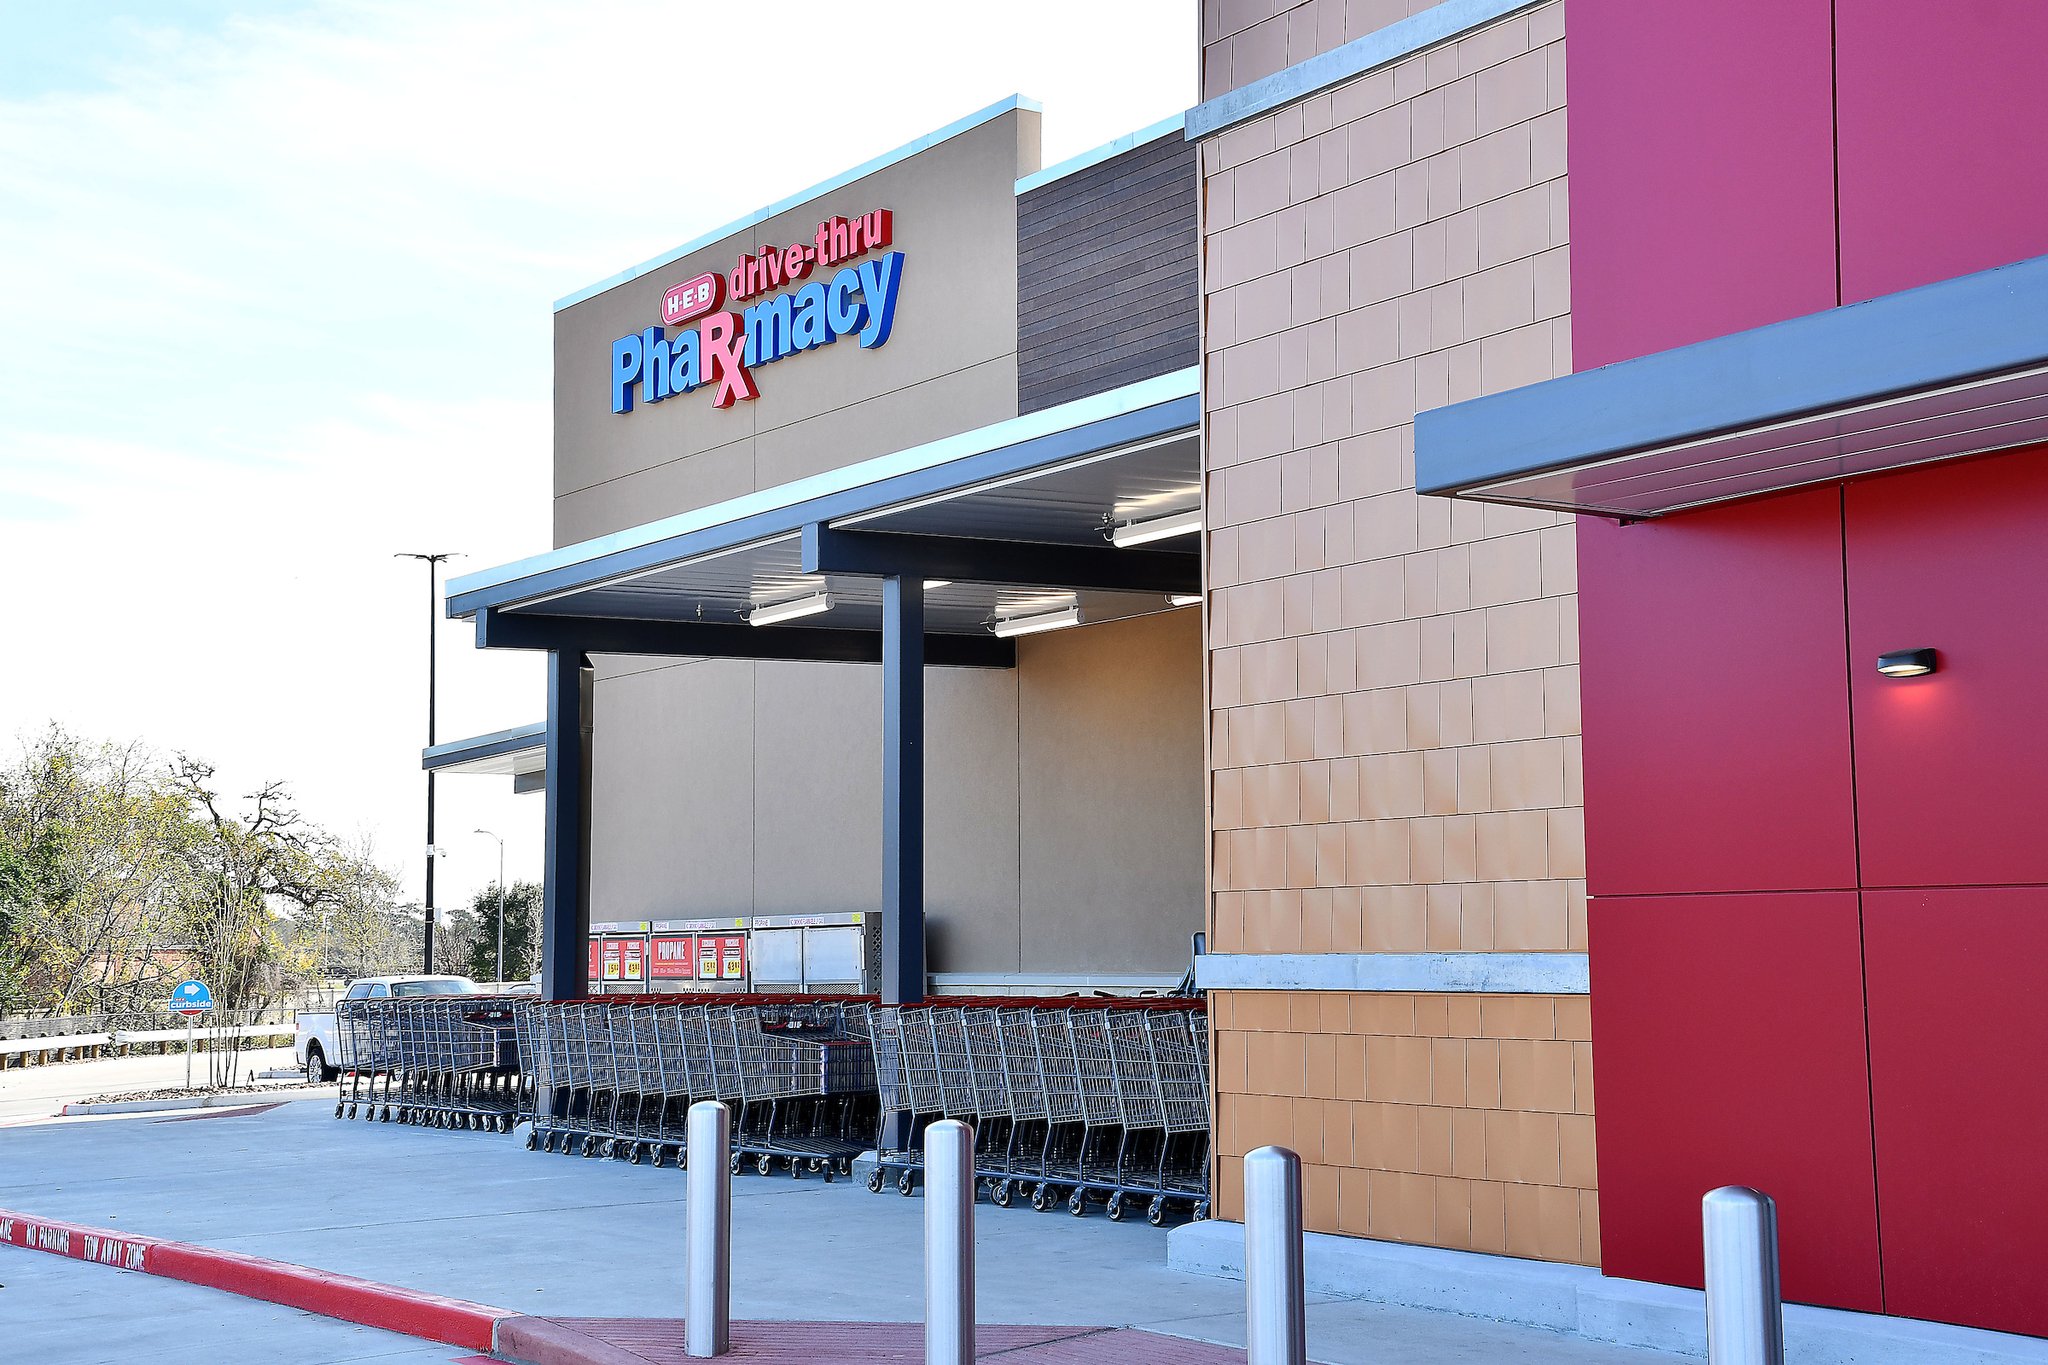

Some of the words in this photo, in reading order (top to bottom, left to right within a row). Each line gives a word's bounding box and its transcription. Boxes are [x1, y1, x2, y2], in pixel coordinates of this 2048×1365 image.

[729, 209, 890, 301] drive-thru
[657, 941, 687, 960] PROPANE
[170, 1000, 211, 1008] curbside
[26, 1222, 37, 1246] NO
[39, 1226, 70, 1254] PARKING
[83, 1235, 99, 1261] TOW
[100, 1238, 123, 1266] AWAY
[125, 1243, 146, 1270] ZONE
